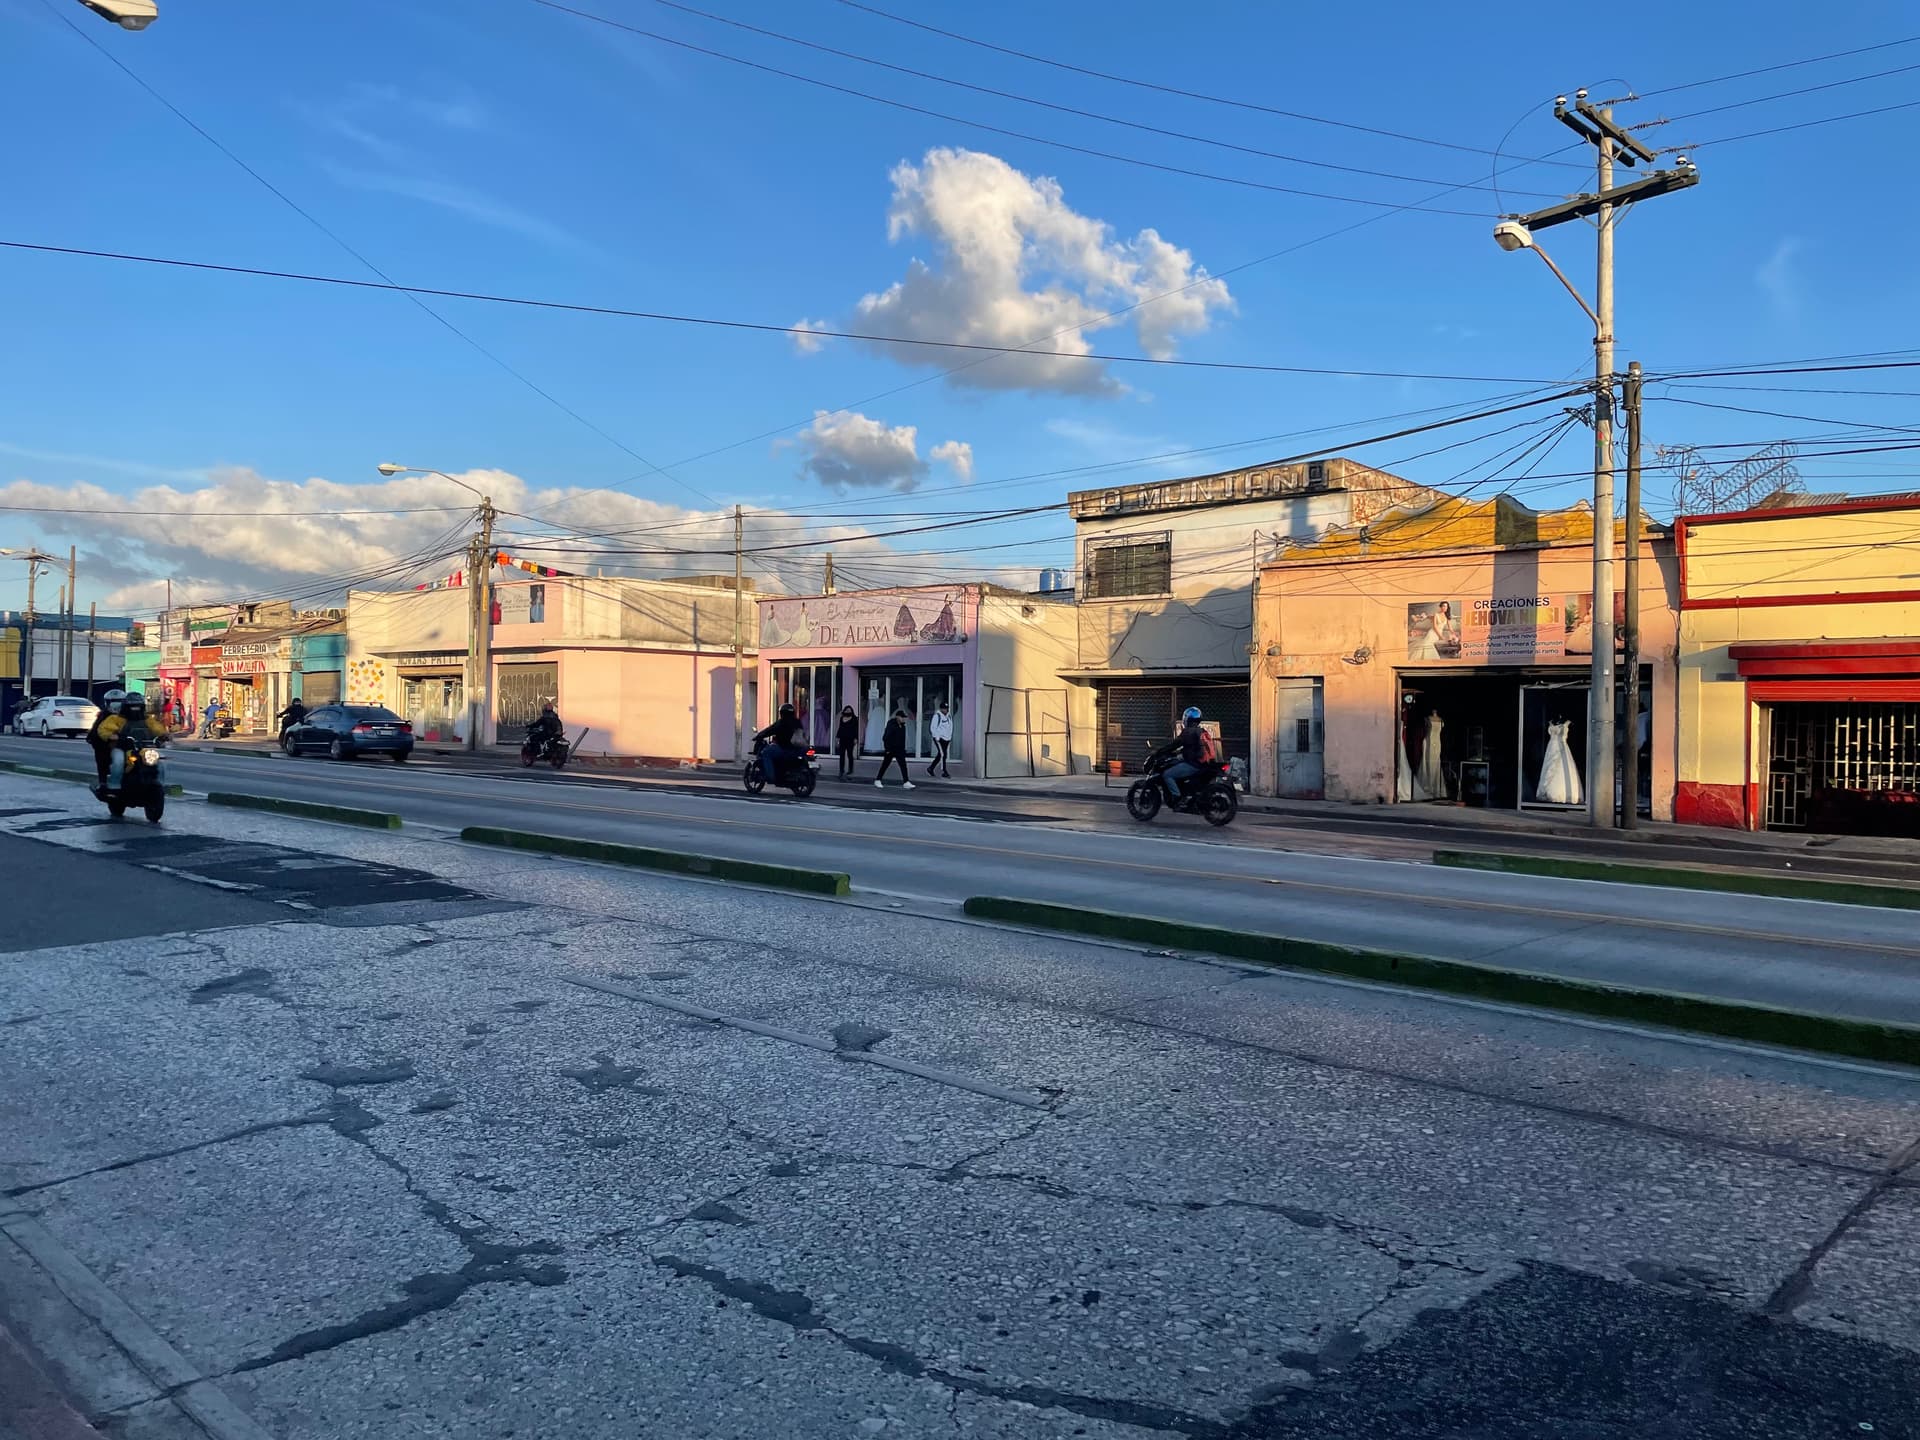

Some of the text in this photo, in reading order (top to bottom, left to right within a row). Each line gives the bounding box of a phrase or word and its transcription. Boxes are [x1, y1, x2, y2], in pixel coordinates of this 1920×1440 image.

[1473, 597, 1551, 609] CREACIONES
[820, 623, 892, 646] DE ALEXA
